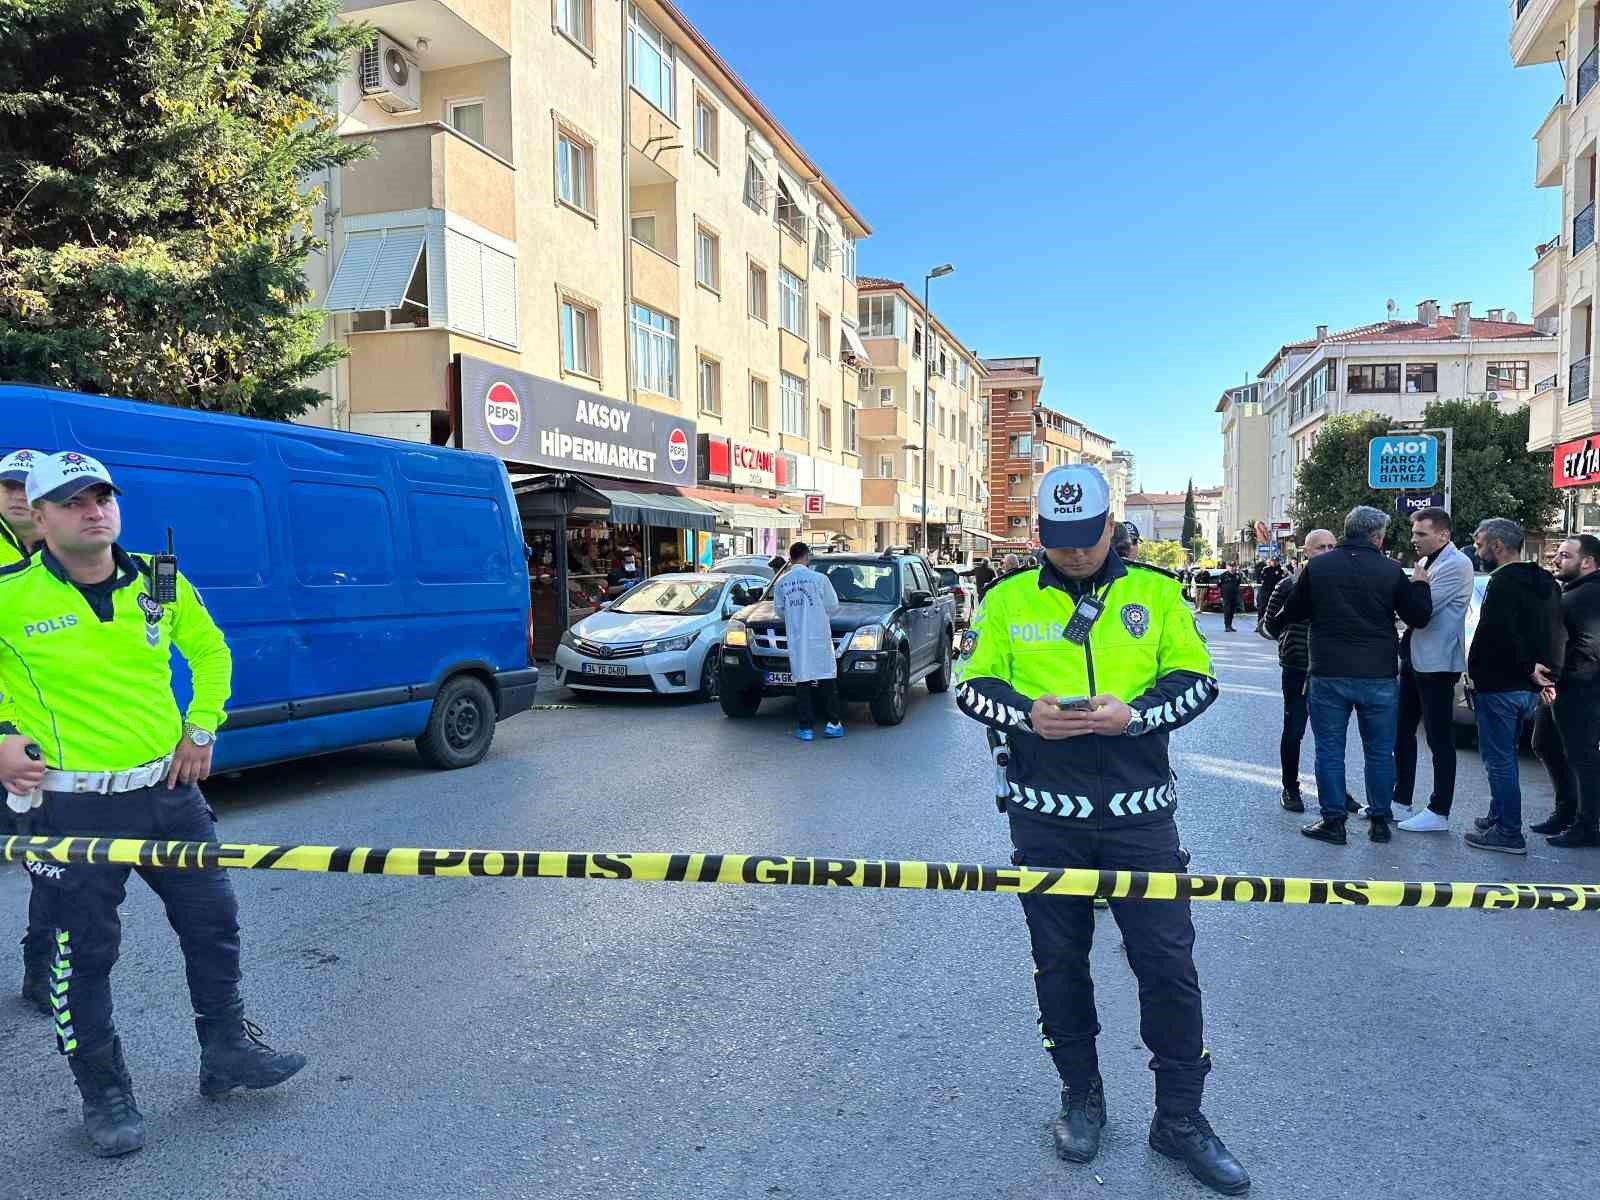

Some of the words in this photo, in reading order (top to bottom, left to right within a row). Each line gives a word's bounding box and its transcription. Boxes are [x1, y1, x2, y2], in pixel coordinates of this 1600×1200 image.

[487, 405, 519, 422] PEPSI
[575, 400, 631, 433] AKSOY
[540, 427, 656, 473] HİPERMARKET
[670, 445, 688, 457] PEPSI
[734, 444, 775, 474] ECZANE
[1380, 455, 1426, 464] HARCA
[62, 464, 98, 476] POLİS
[1380, 464, 1426, 473] HARCA
[808, 497, 820, 511] E
[1053, 506, 1083, 515] POLİS
[24, 614, 78, 638] POLİS
[768, 672, 781, 682] 34
